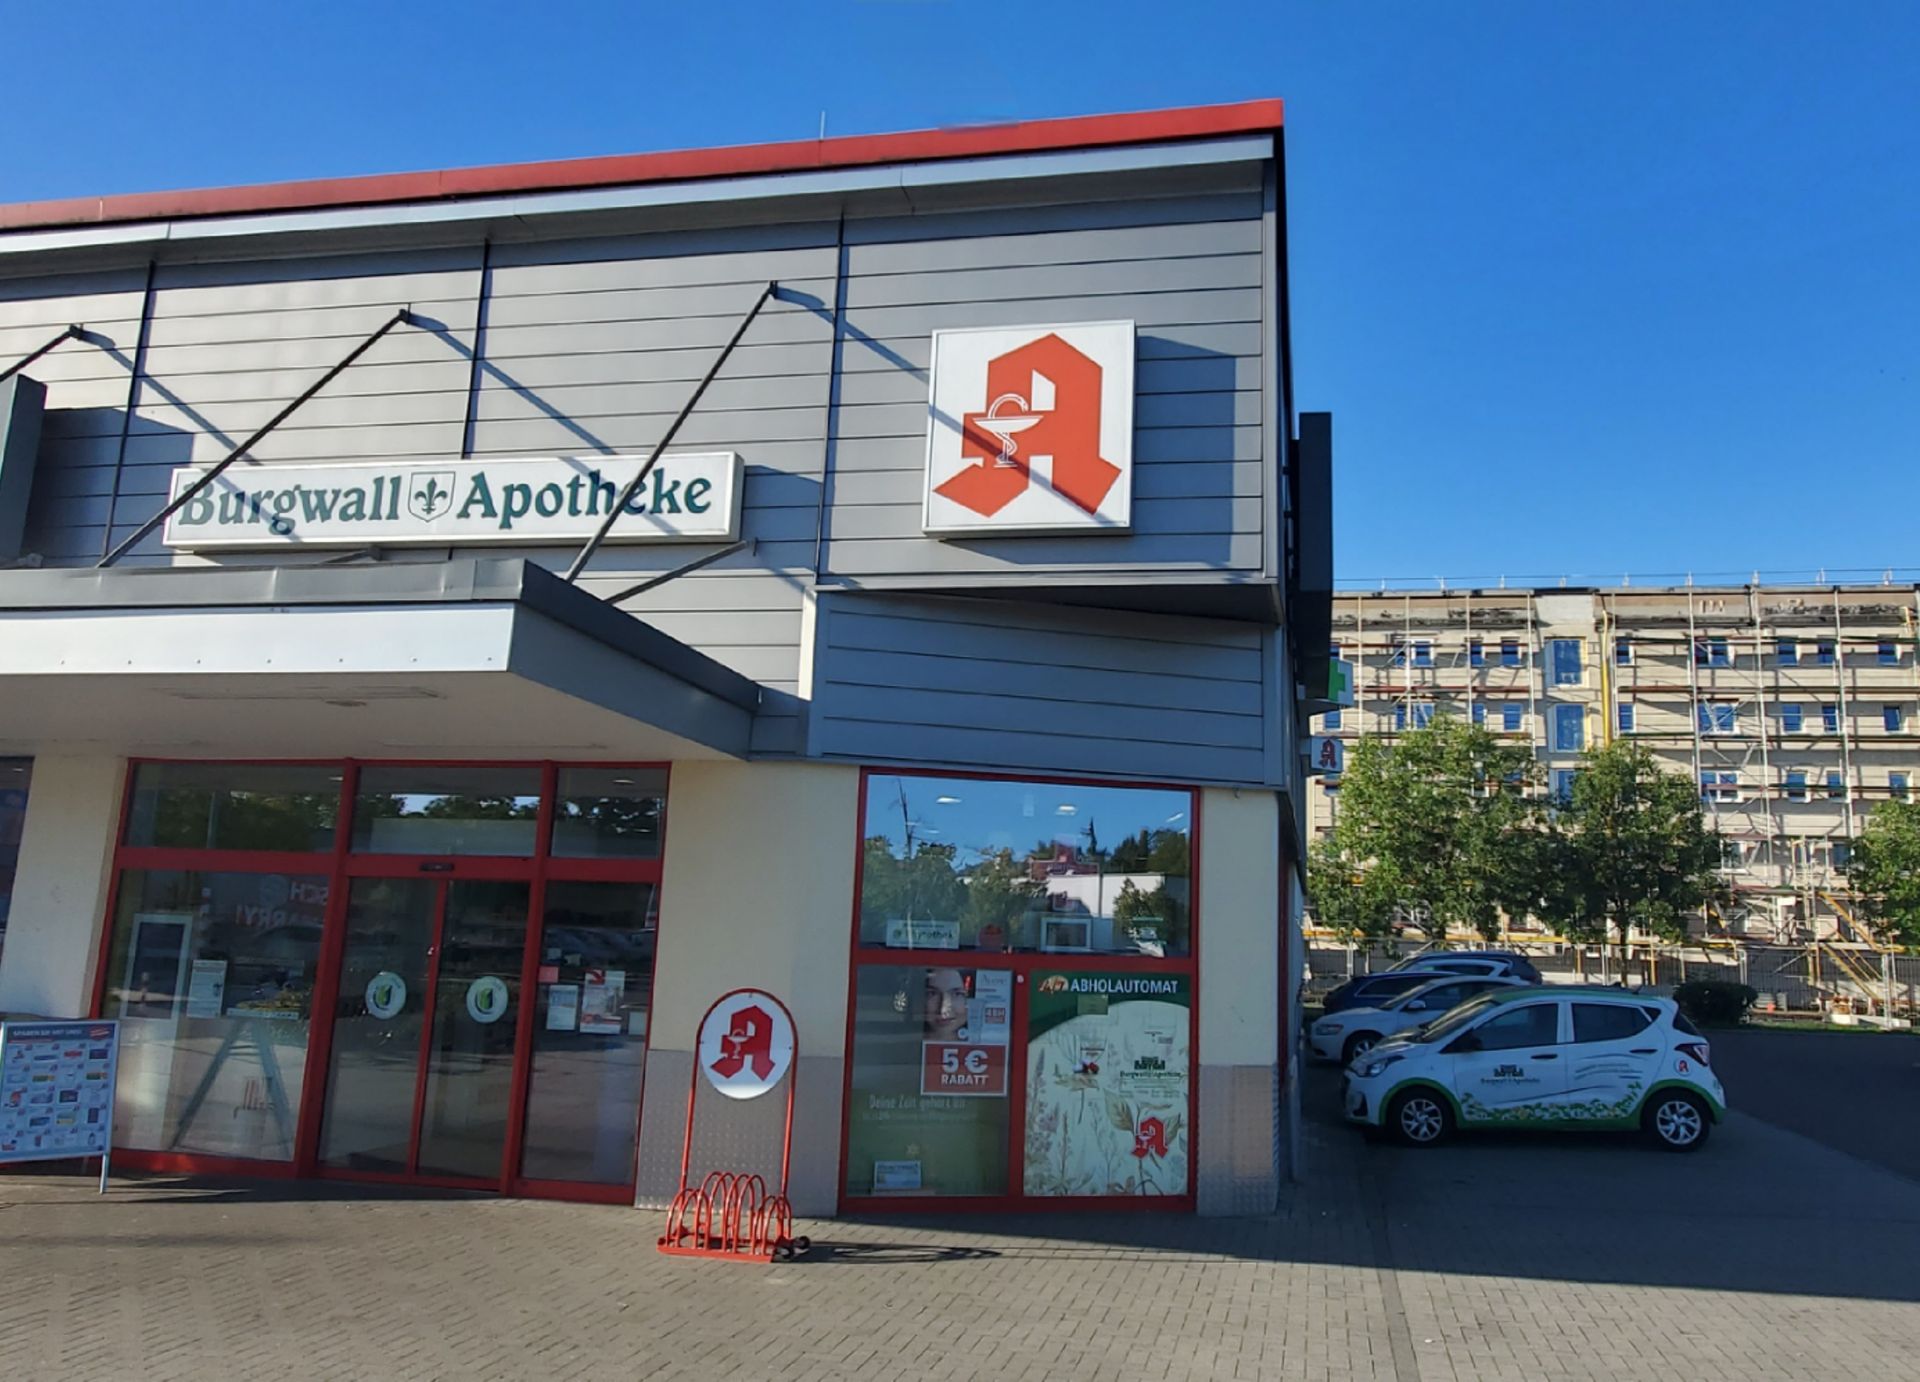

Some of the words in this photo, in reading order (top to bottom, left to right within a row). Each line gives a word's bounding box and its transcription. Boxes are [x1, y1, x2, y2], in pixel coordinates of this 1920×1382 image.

[178, 475, 401, 535] Burgwall
[456, 467, 713, 529] Apotheke
[1070, 978, 1178, 993] ABHOLAUTOMAT
[941, 1048, 959, 1073] 5
[964, 1049, 989, 1073] €
[941, 1074, 990, 1086] RABATT
